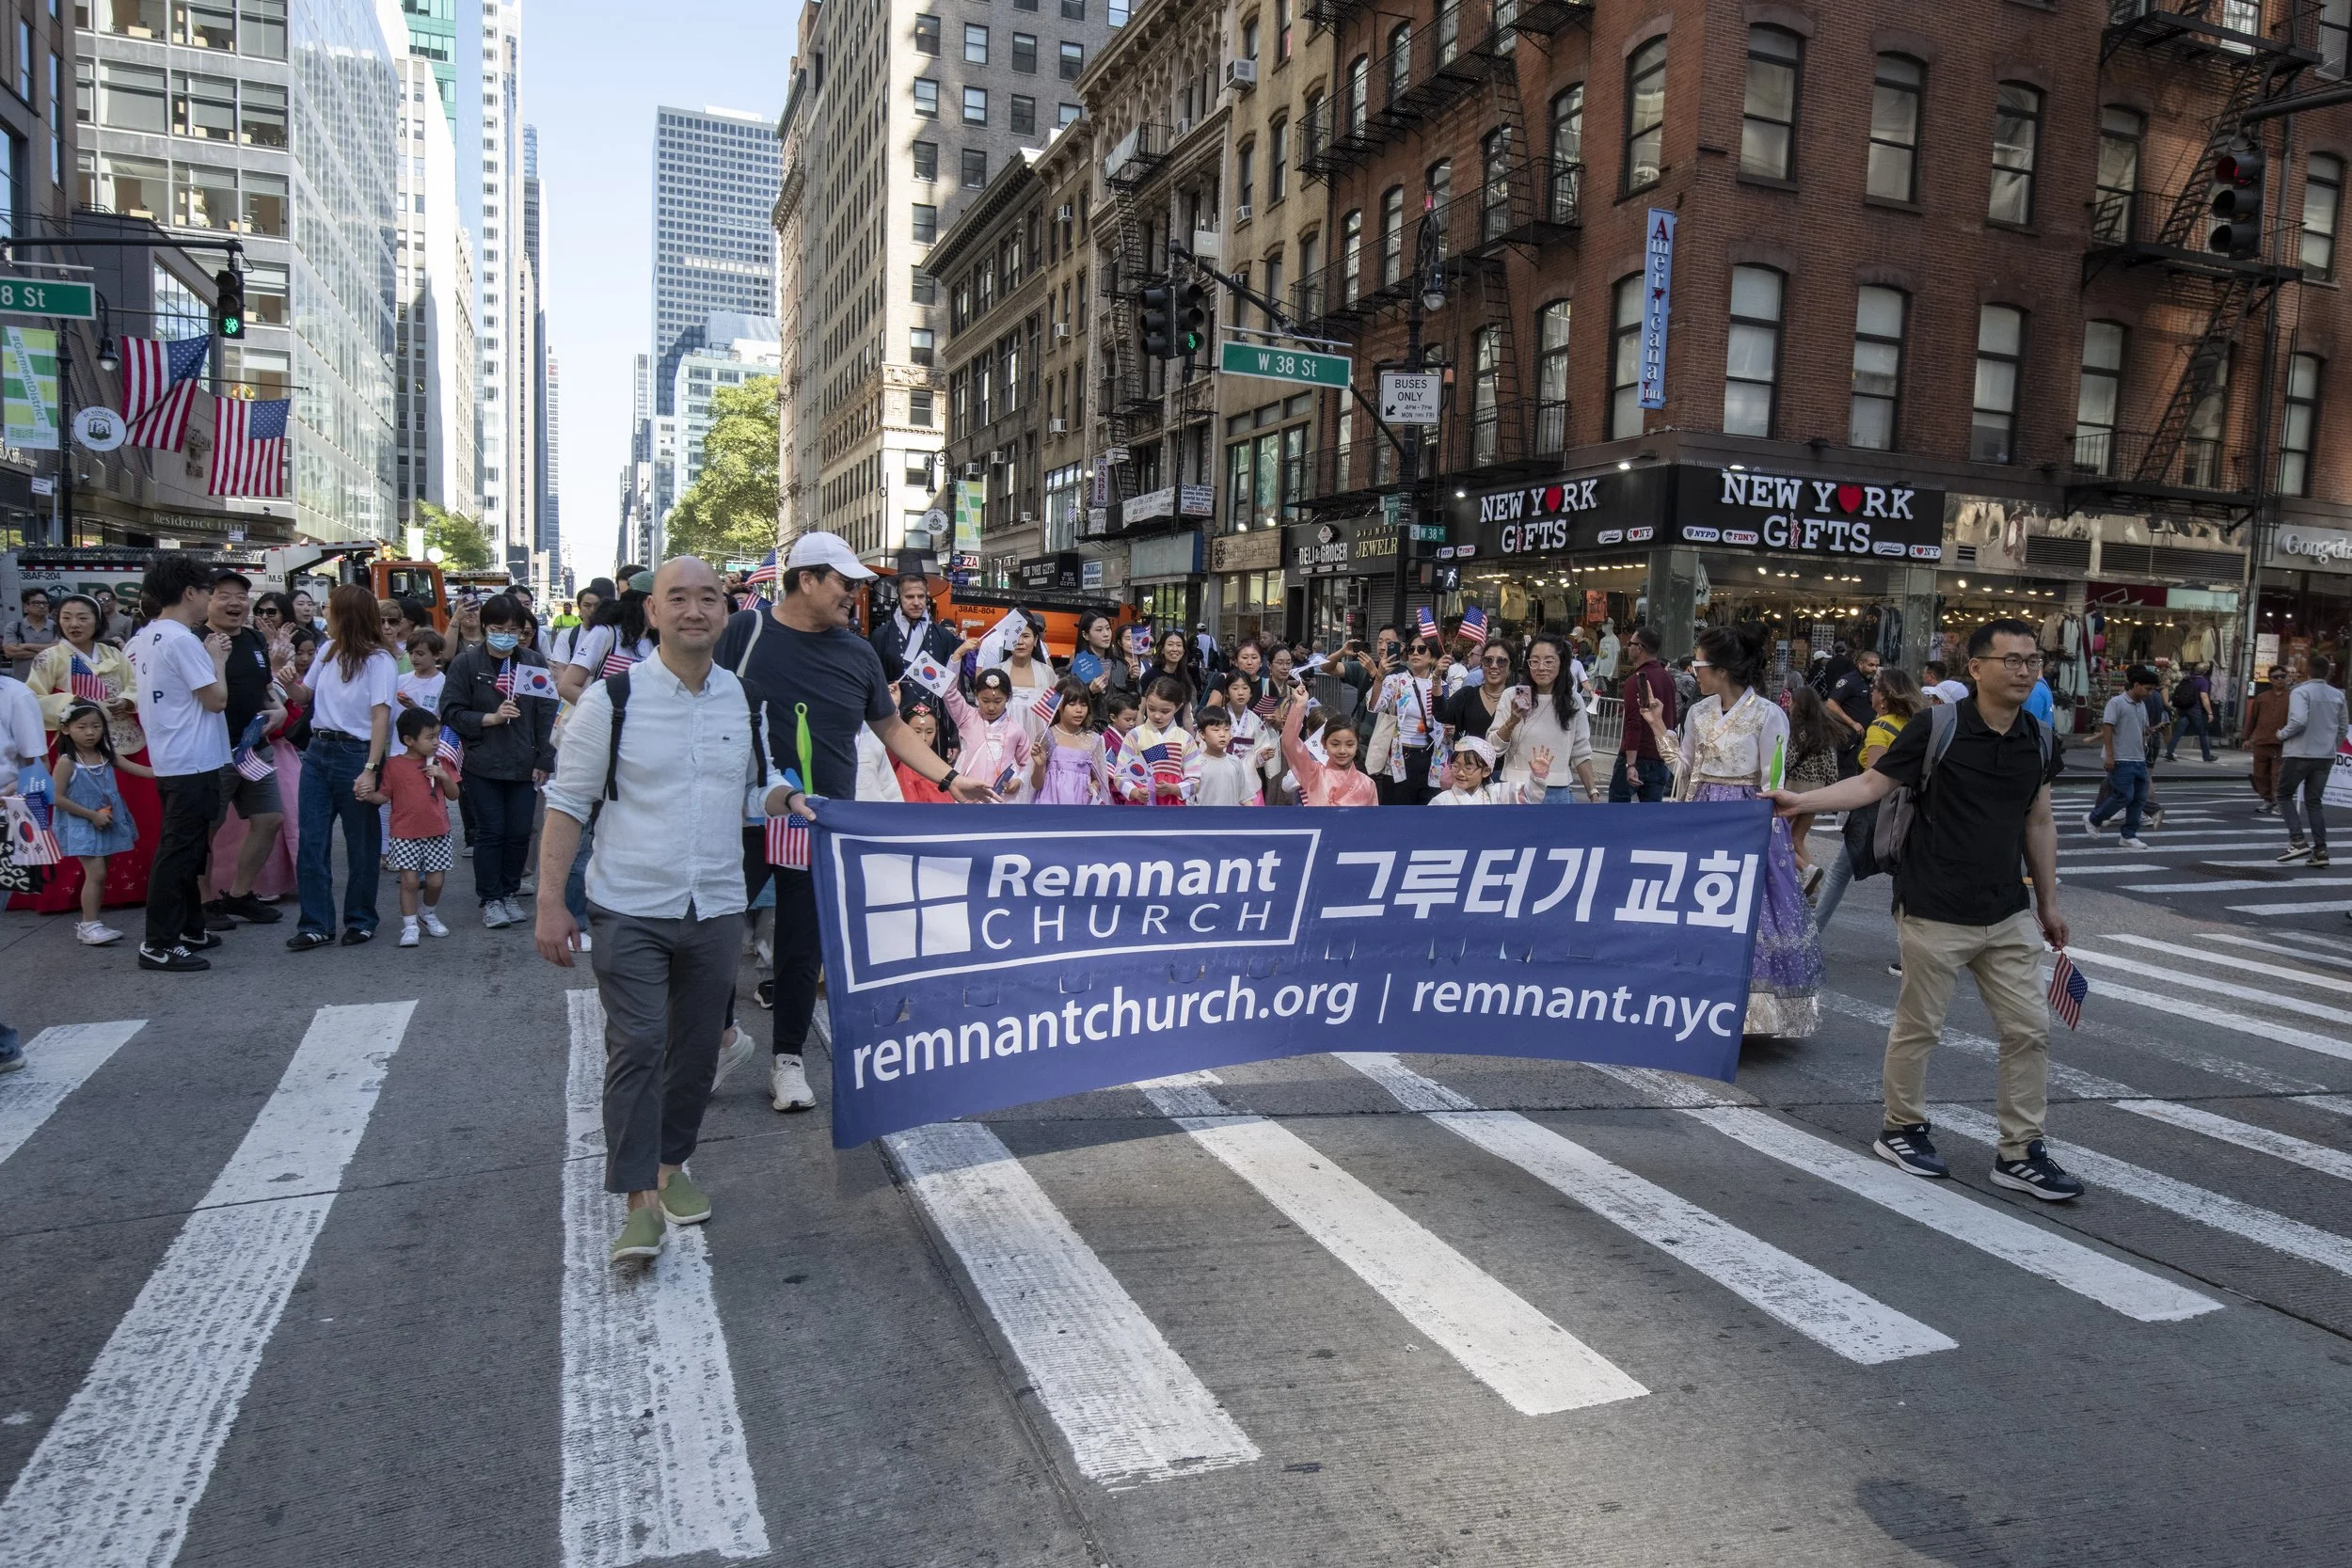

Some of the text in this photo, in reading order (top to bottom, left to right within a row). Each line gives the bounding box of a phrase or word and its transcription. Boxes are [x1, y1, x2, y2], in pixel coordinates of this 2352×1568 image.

[24, 287, 46, 308] St
[1643, 216, 1670, 402] Americana Inn
[1258, 353, 1317, 377] W 38 St
[10, 334, 46, 422] #GarmentDistrict
[1394, 378, 1427, 389] BUSES
[1397, 391, 1423, 402] ONLY
[1721, 471, 1803, 510] NEW
[1480, 490, 1526, 523] NEW
[153, 513, 245, 532] Residence Inn
[1639, 528, 1651, 538] NY
[1420, 529, 1427, 539] W
[1428, 529, 1438, 540] 38
[1693, 530, 1717, 539] NYPD
[1733, 532, 1755, 542] FDNY
[1299, 546, 1315, 564] DELI
[1321, 542, 1348, 563] GROCER
[1356, 537, 1398, 558] JEWELR
[1924, 547, 1939, 557] NY
[2281, 533, 2328, 564] Gong
[21, 572, 61, 581] 38AF-204
[268, 573, 282, 583] M.5
[958, 605, 995, 615] 38AE-804
[152, 689, 165, 704] P
[987, 849, 1282, 897] Remnant
[1320, 847, 1759, 935] 그루터기 교회
[980, 900, 1273, 950] CHURCH
[852, 975, 1359, 1090] remnantchurch.org
[1411, 980, 1738, 1042] remnant.nyc
